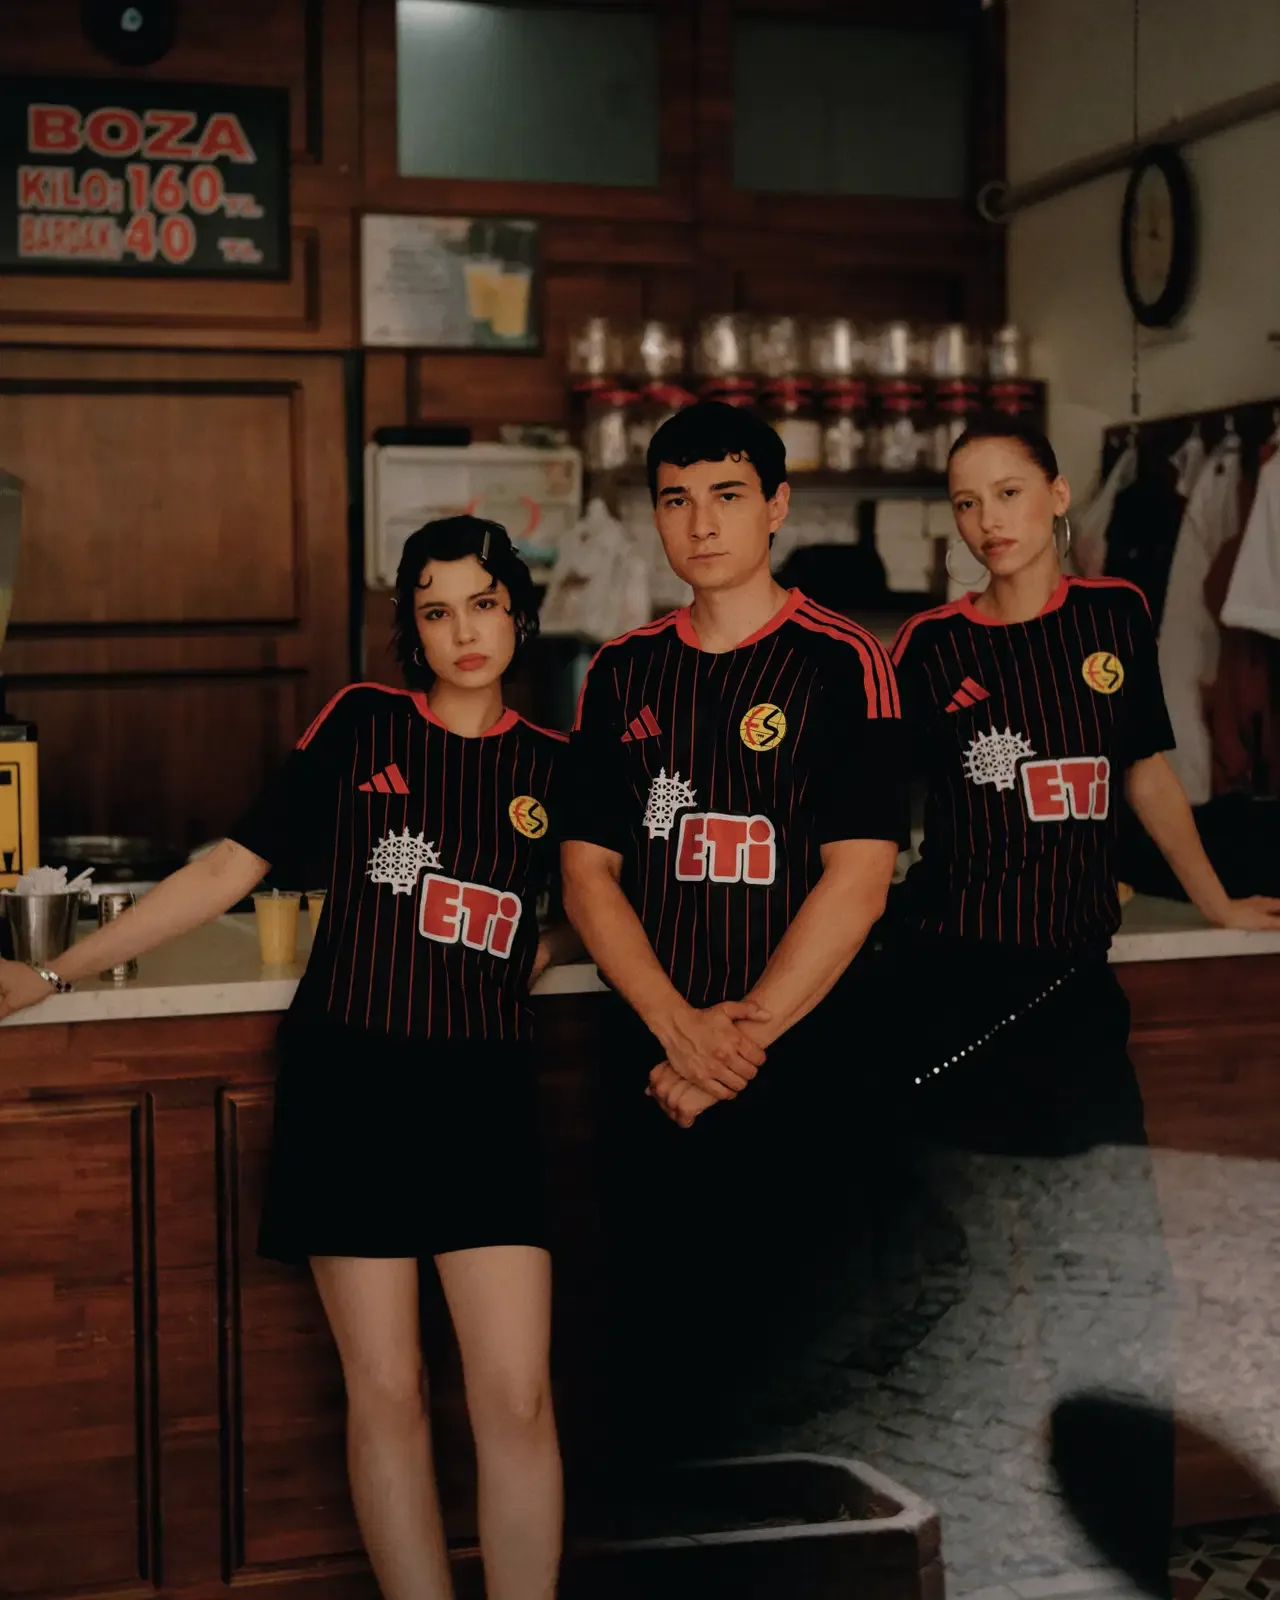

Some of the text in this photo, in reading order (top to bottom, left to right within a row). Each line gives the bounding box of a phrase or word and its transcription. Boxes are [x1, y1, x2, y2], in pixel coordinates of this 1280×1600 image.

[28, 104, 256, 163] BOZA
[126, 164, 223, 214] 160
[124, 211, 196, 263] 40
